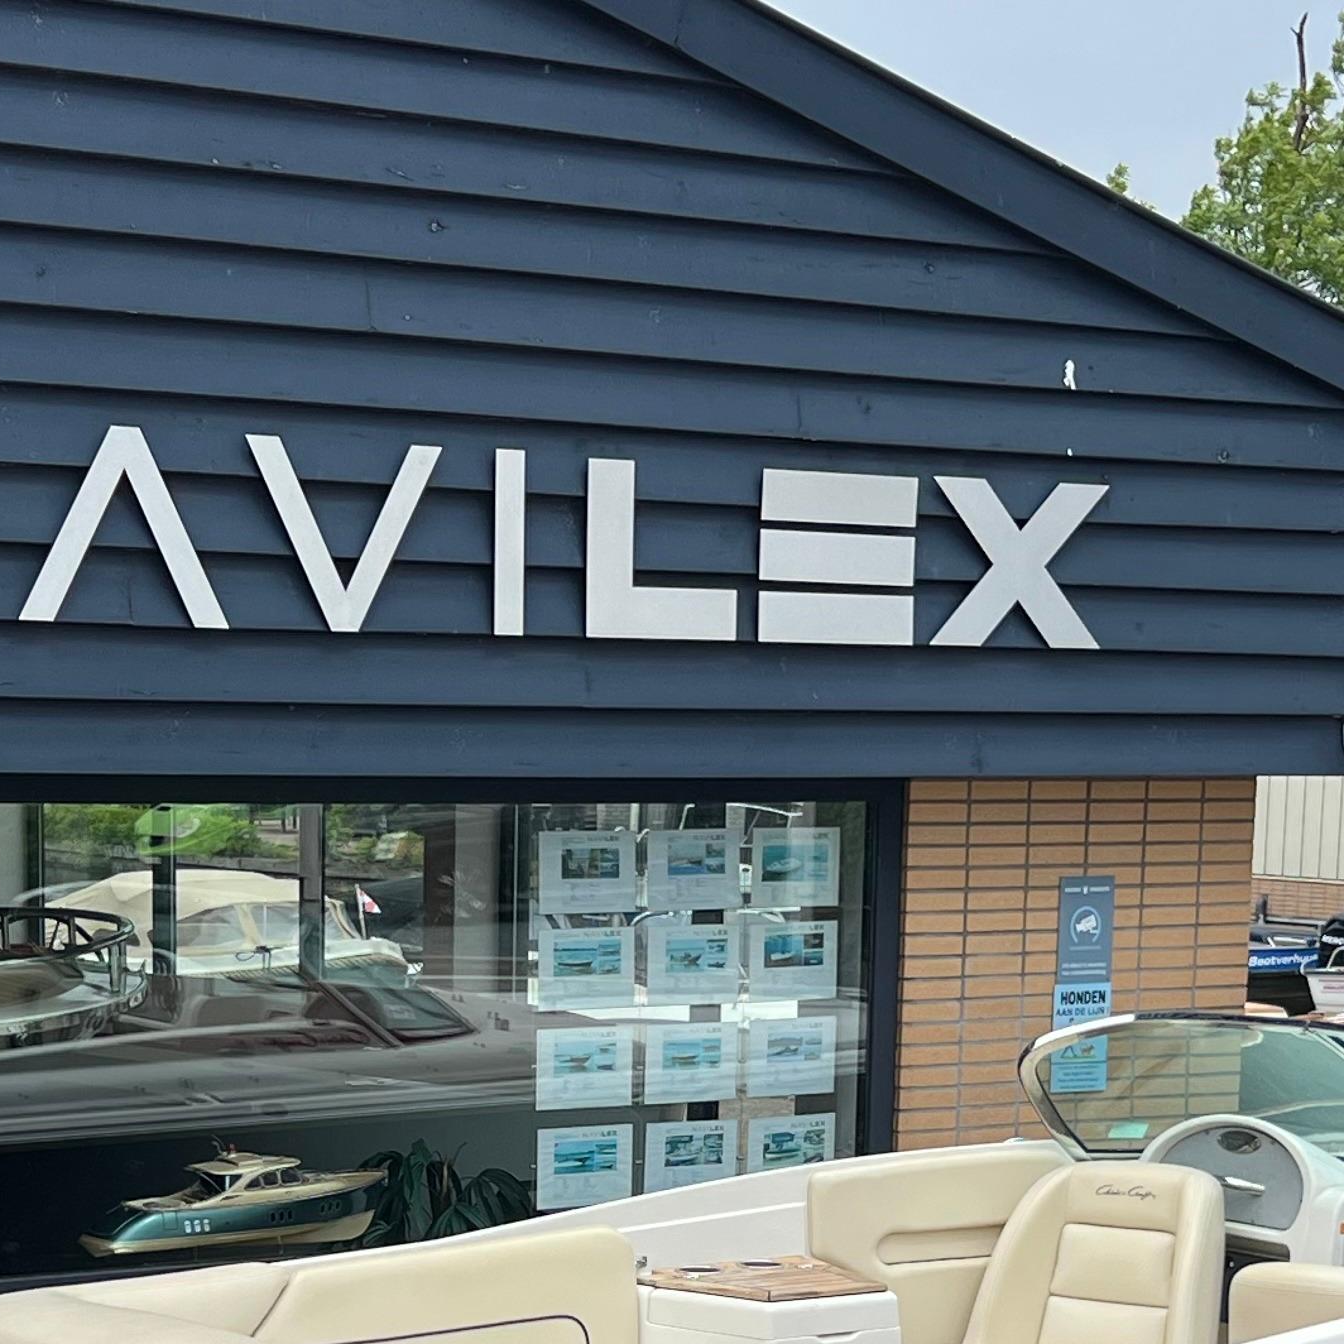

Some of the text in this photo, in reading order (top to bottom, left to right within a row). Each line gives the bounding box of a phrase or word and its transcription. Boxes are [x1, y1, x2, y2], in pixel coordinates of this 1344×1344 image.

[1060, 990, 1106, 1006] HONDEN
[1056, 1007, 1073, 1017] AAN
[1074, 1007, 1086, 1016] DE
